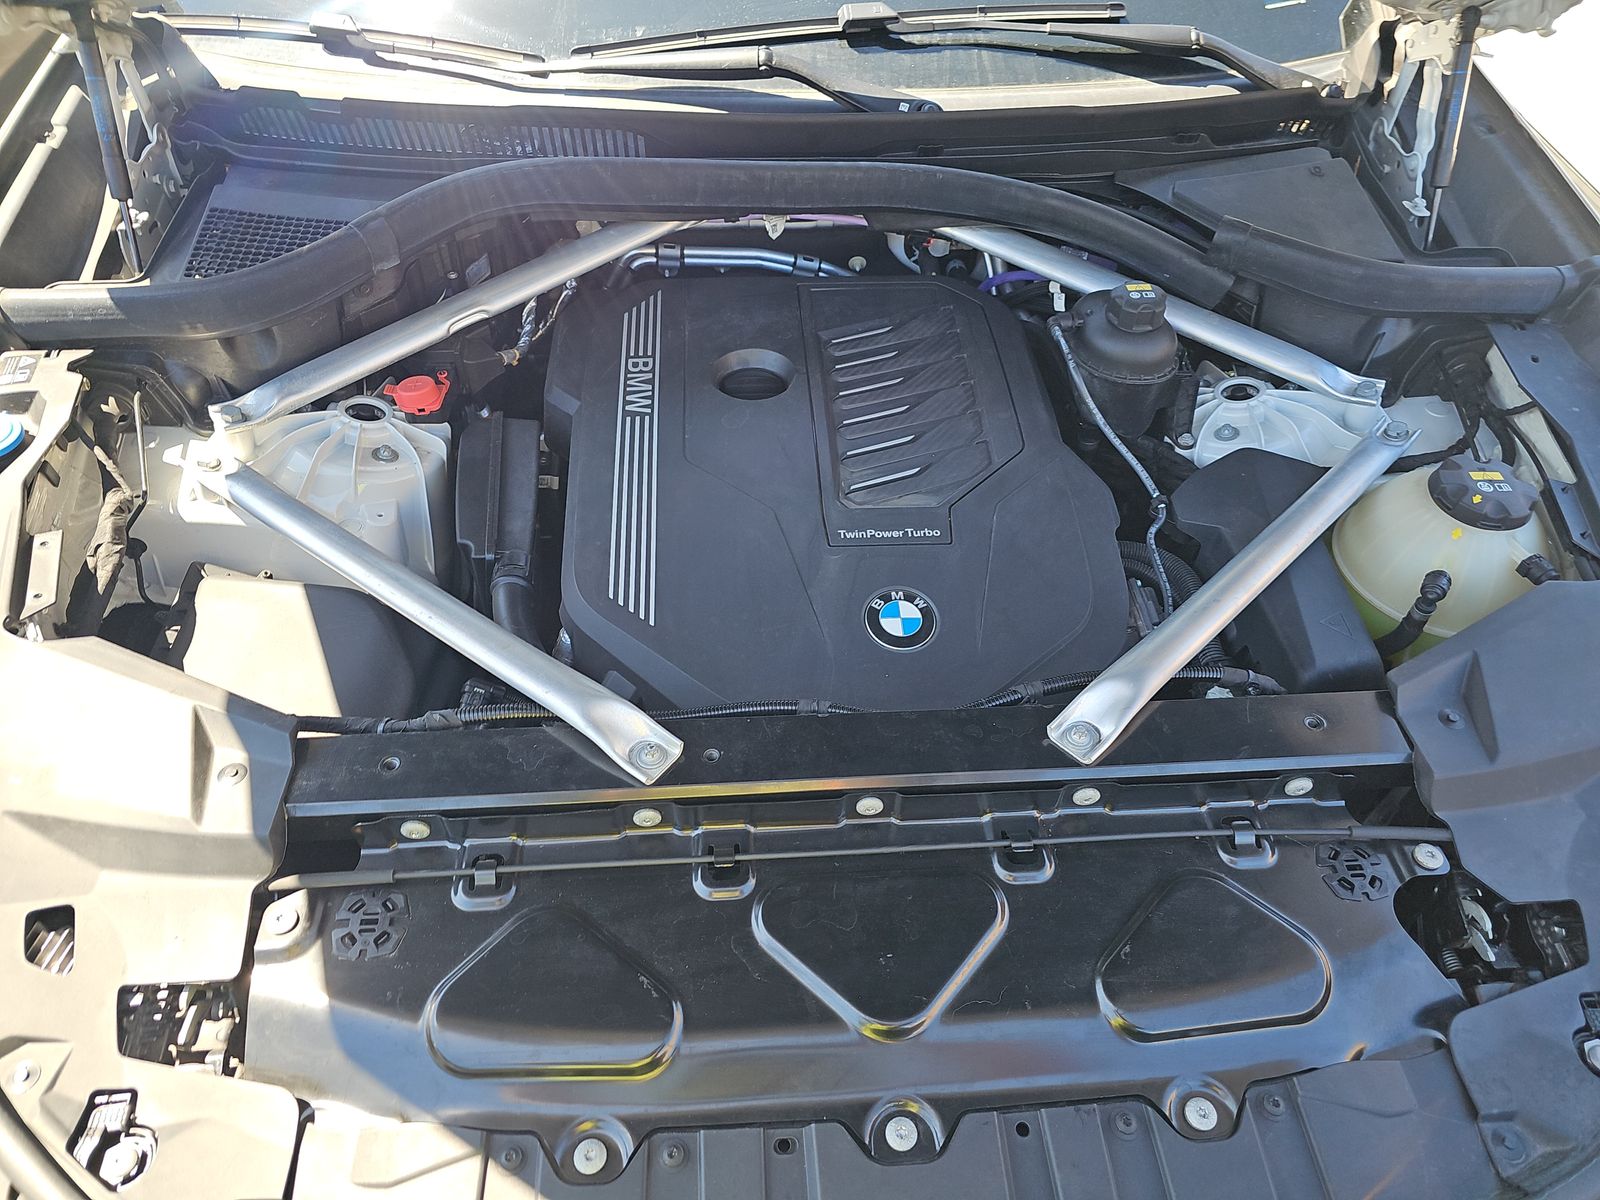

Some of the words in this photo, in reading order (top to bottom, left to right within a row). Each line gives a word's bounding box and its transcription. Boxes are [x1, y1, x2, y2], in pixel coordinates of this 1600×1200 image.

[625, 358, 653, 413] BMW
[905, 528, 941, 538] Turbo
[871, 591, 927, 610] BMW
